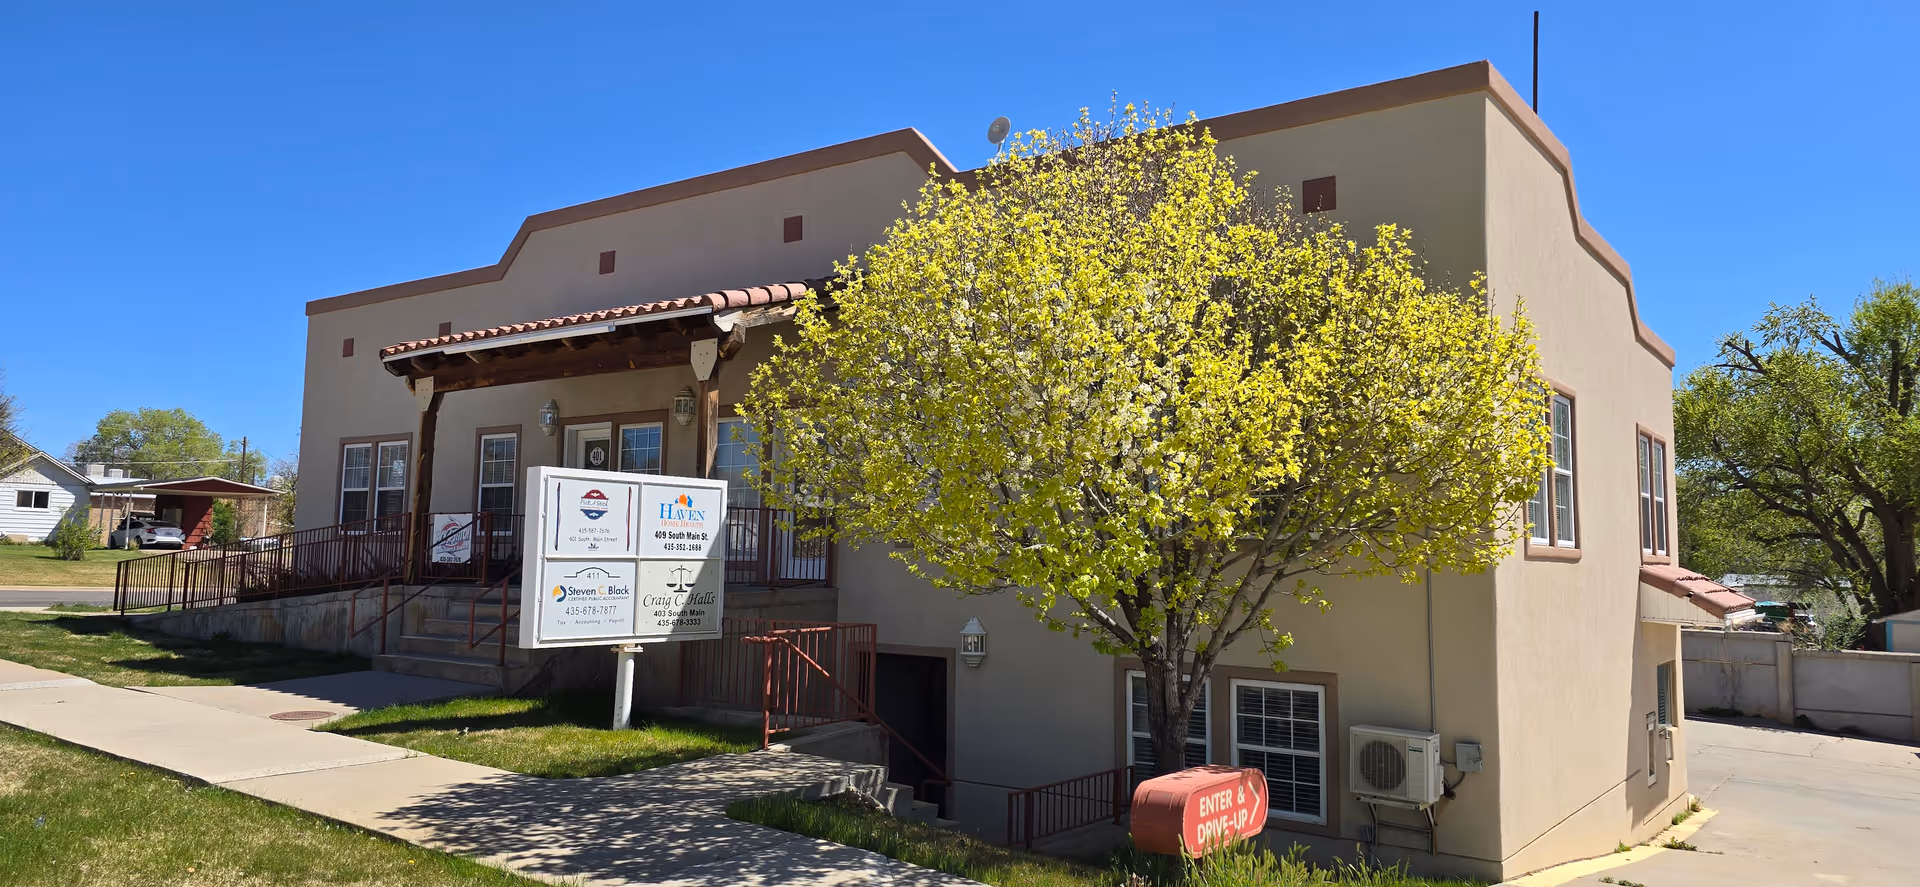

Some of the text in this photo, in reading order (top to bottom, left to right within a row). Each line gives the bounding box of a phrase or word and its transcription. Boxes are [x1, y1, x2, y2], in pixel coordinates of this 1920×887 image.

[592, 450, 602, 461] 401
[660, 502, 706, 521] HAVEN
[661, 520, 704, 528] HOME HEALTH
[654, 530, 709, 540] 409 South Main St.
[568, 584, 630, 596] Steven C. Black
[643, 592, 716, 610] Craig C. Halls
[566, 606, 616, 616] 435-678-7877
[689, 608, 705, 616] Main
[657, 618, 701, 626] 435-678-3333
[1200, 785, 1246, 818] ENTER &
[1197, 808, 1248, 845] DRIVE-UP
